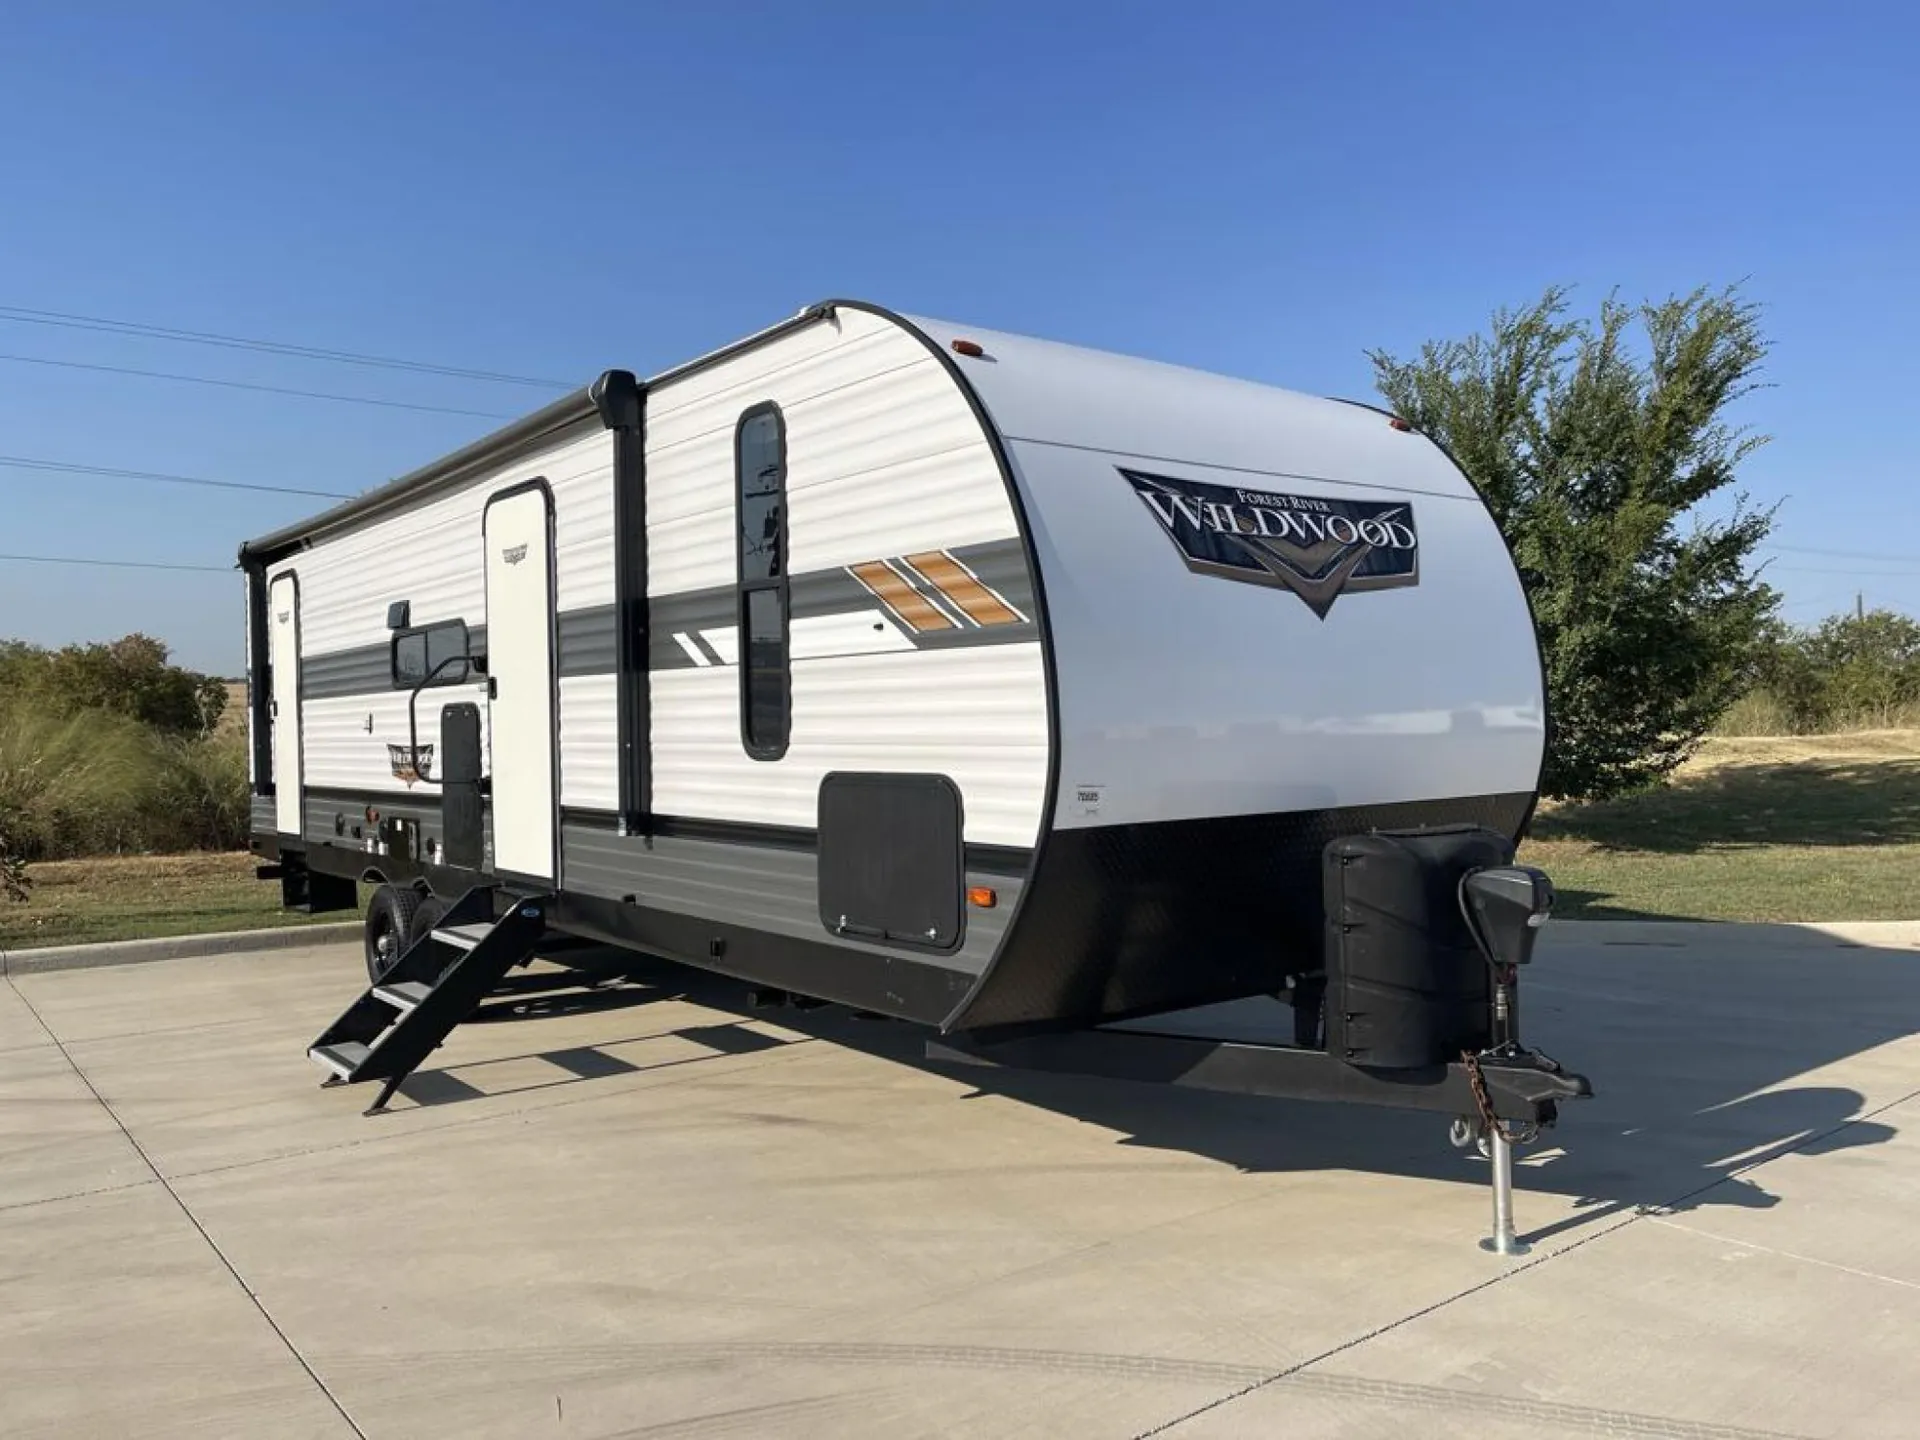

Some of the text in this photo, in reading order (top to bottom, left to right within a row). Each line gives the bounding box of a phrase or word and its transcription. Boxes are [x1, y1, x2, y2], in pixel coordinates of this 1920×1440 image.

[1136, 490, 1417, 550] WILDWOOD
[1236, 489, 1331, 513] FOREST RIVER
